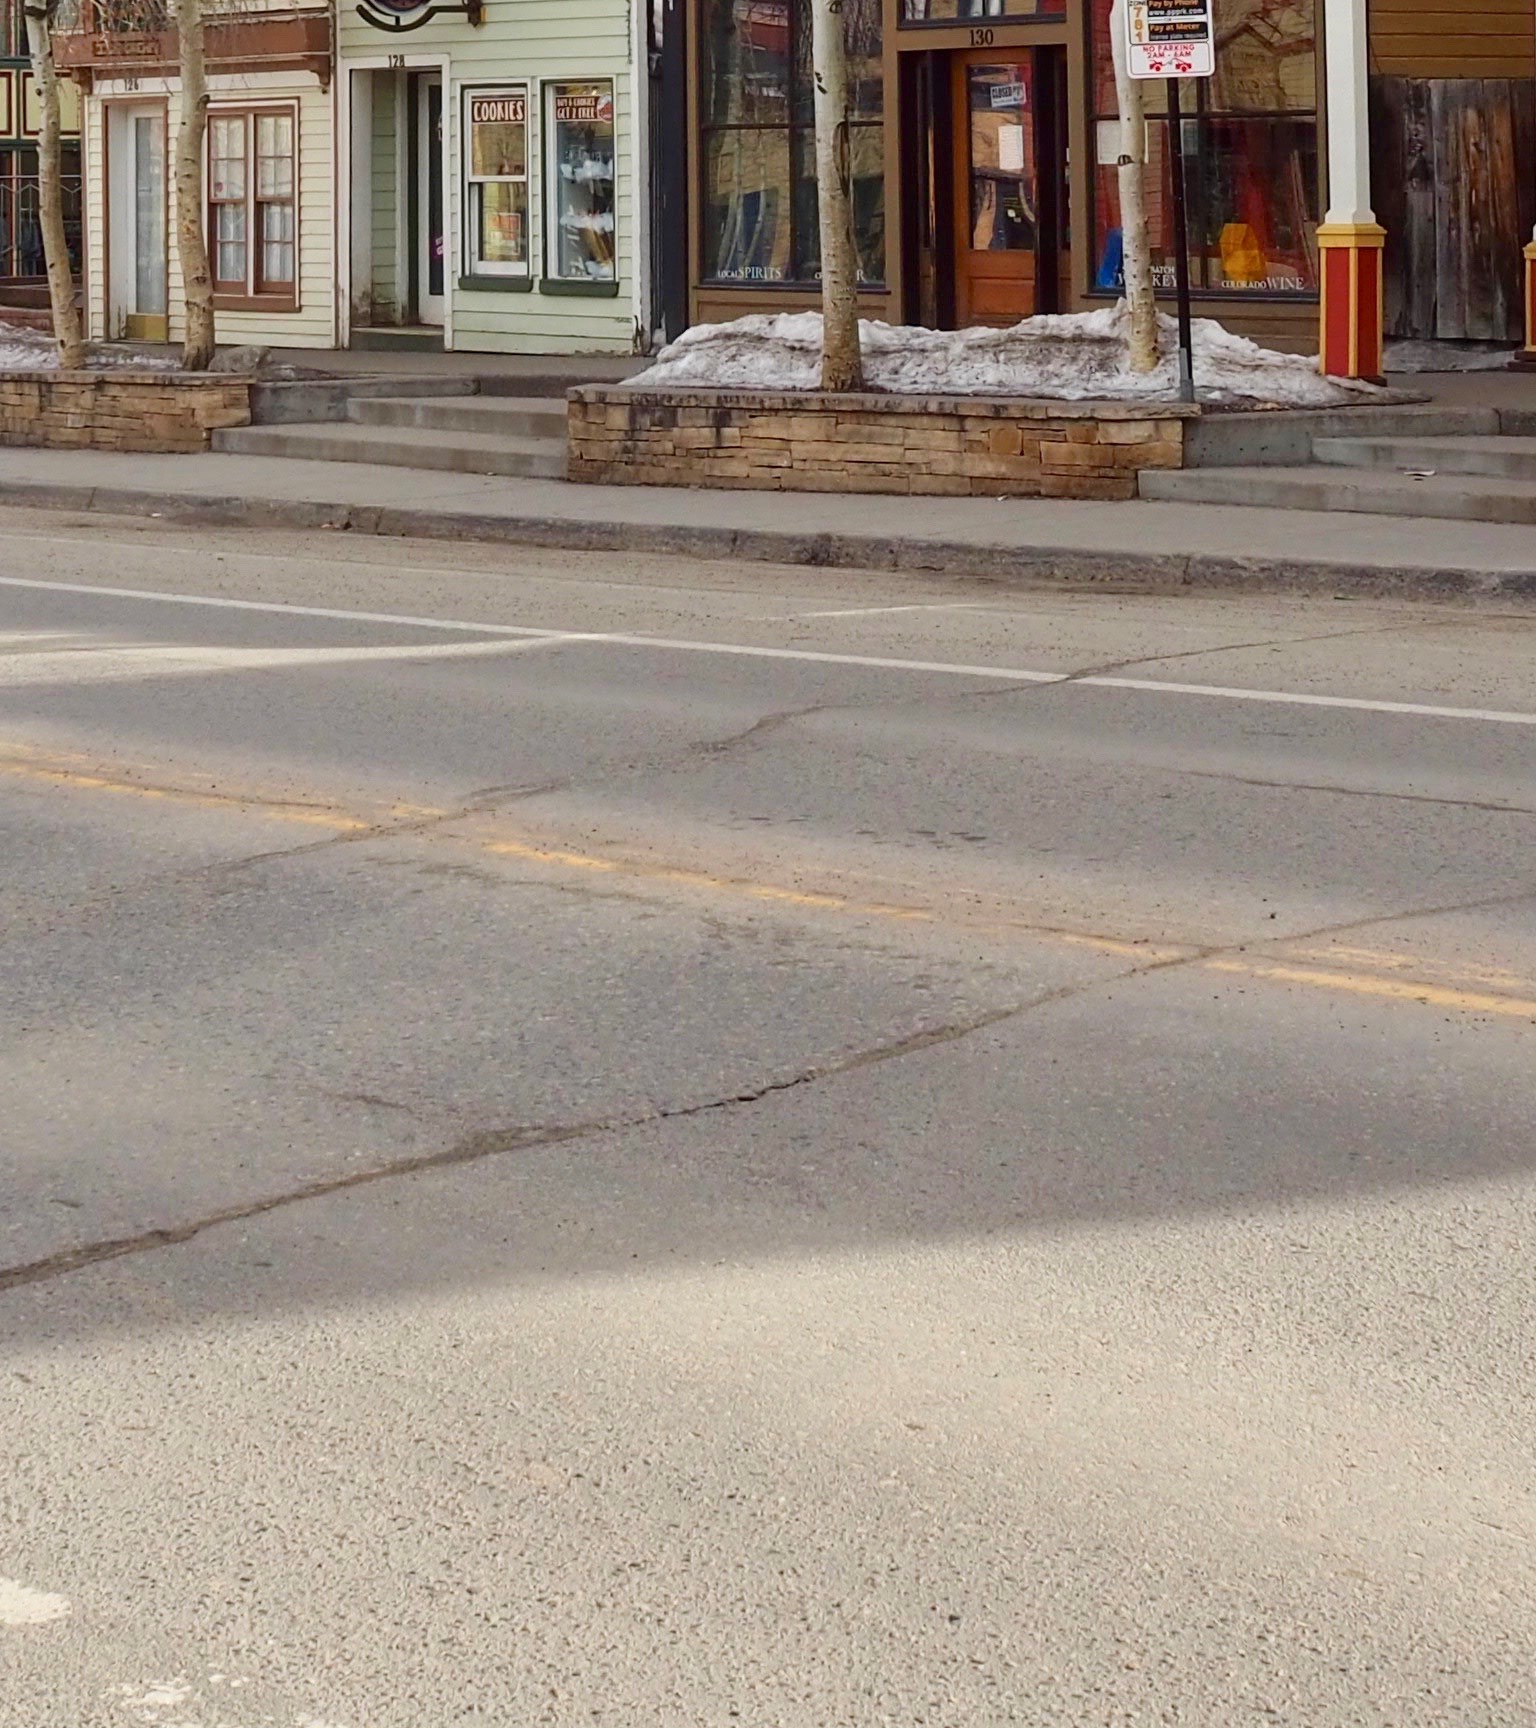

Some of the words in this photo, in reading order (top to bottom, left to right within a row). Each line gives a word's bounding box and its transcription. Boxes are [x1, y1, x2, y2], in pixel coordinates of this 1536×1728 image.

[1148, 0, 1163, 9] Pay
[1164, 0, 1174, 8] by
[1150, 24, 1164, 33] Pay
[1166, 24, 1175, 32] at
[1176, 22, 1201, 31] Meter
[969, 29, 994, 46] 130
[1143, 45, 1156, 53] NO
[1157, 43, 1196, 52] PARKING
[388, 54, 406, 68] 128
[473, 100, 524, 121] COOKIES
[557, 106, 570, 119] GET
[578, 106, 595, 119] FREE
[738, 266, 782, 280] SPIRITS
[1221, 279, 1266, 290] COLORADO
[1266, 276, 1305, 290] WINE
